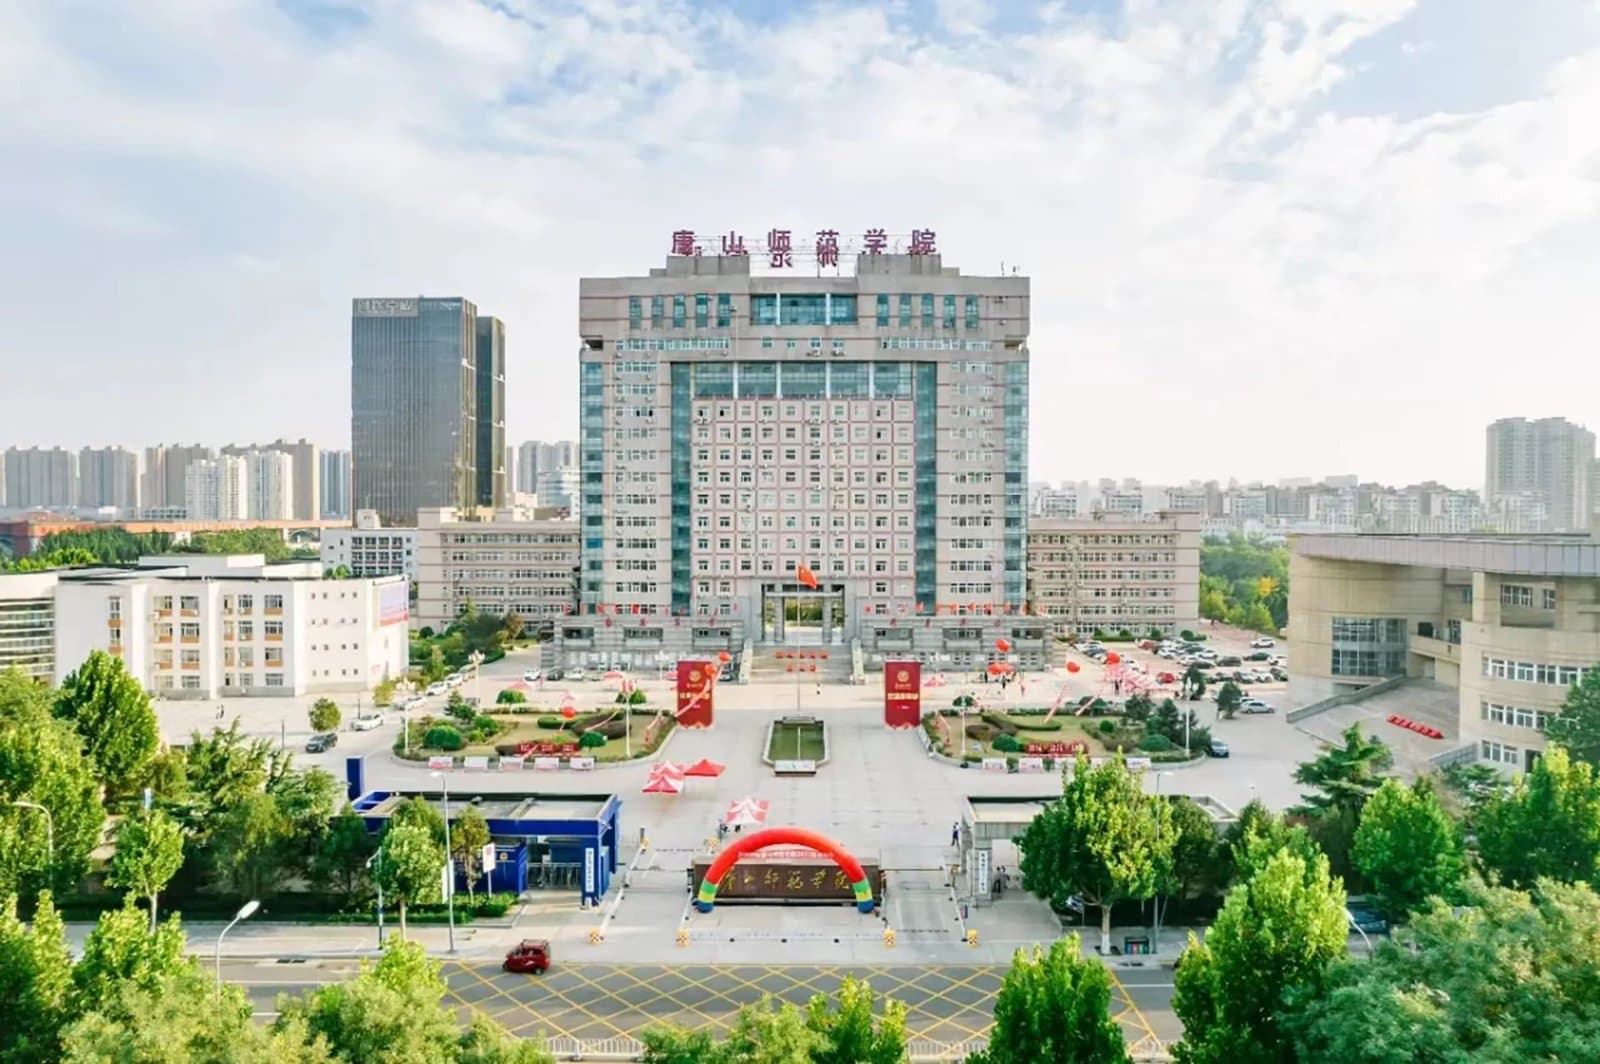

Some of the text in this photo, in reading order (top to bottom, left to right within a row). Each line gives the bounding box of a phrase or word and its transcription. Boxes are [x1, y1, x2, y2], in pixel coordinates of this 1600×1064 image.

[671, 228, 937, 256] 唐山师范学院
